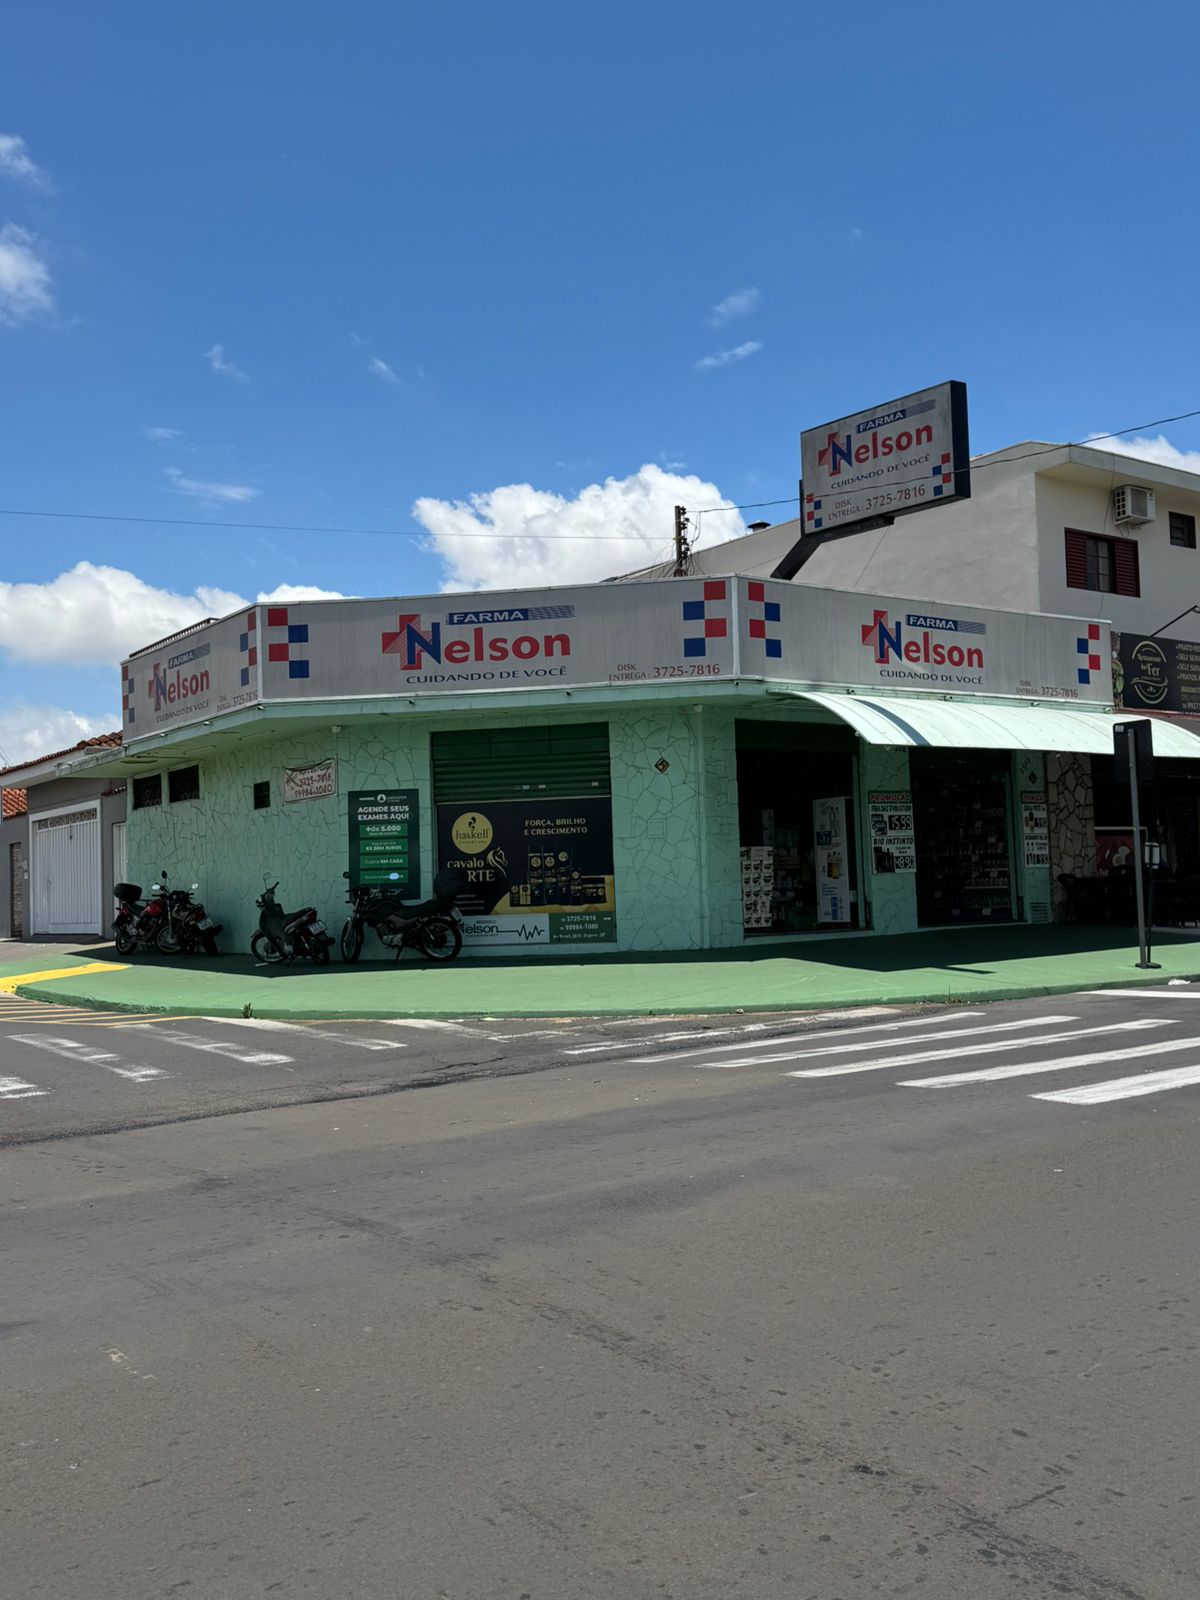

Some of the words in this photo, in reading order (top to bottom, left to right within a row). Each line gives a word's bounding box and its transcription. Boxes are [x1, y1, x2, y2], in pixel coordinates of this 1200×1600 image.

[858, 410, 905, 432] FARMA
[831, 424, 933, 472] Nelson
[831, 468, 884, 490] CUIDANDO
[886, 463, 900, 473] DE
[902, 453, 931, 468] VOCÊ
[834, 500, 852, 510] DISK
[865, 484, 926, 511] 3725-7816
[452, 609, 525, 624] FARMA
[909, 614, 956, 630] FARMA
[406, 621, 571, 665] Nelson
[878, 618, 984, 669] Nelson
[169, 651, 195, 668] FARMA
[406, 671, 496, 684] CUIDANDO
[499, 669, 521, 680] DE
[524, 665, 568, 678] VOCÊ
[617, 663, 637, 672] DISK
[653, 663, 720, 678] 3725-7816
[879, 669, 939, 682] CUIDANDO
[941, 674, 953, 683] DE
[956, 674, 984, 686] VOCÊ
[154, 668, 209, 704] Nelson
[1041, 686, 1079, 698] 3725-7816
[156, 708, 185, 723] CUIDANDO
[357, 813, 389, 821] EXAMES
[390, 812, 409, 821] AQUI
[556, 817, 586, 826] BRILHO
[455, 828, 489, 840] haskell
[531, 826, 588, 836] CRESCIMENTO
[447, 857, 485, 868] cavalo
[467, 870, 496, 883] RTE
